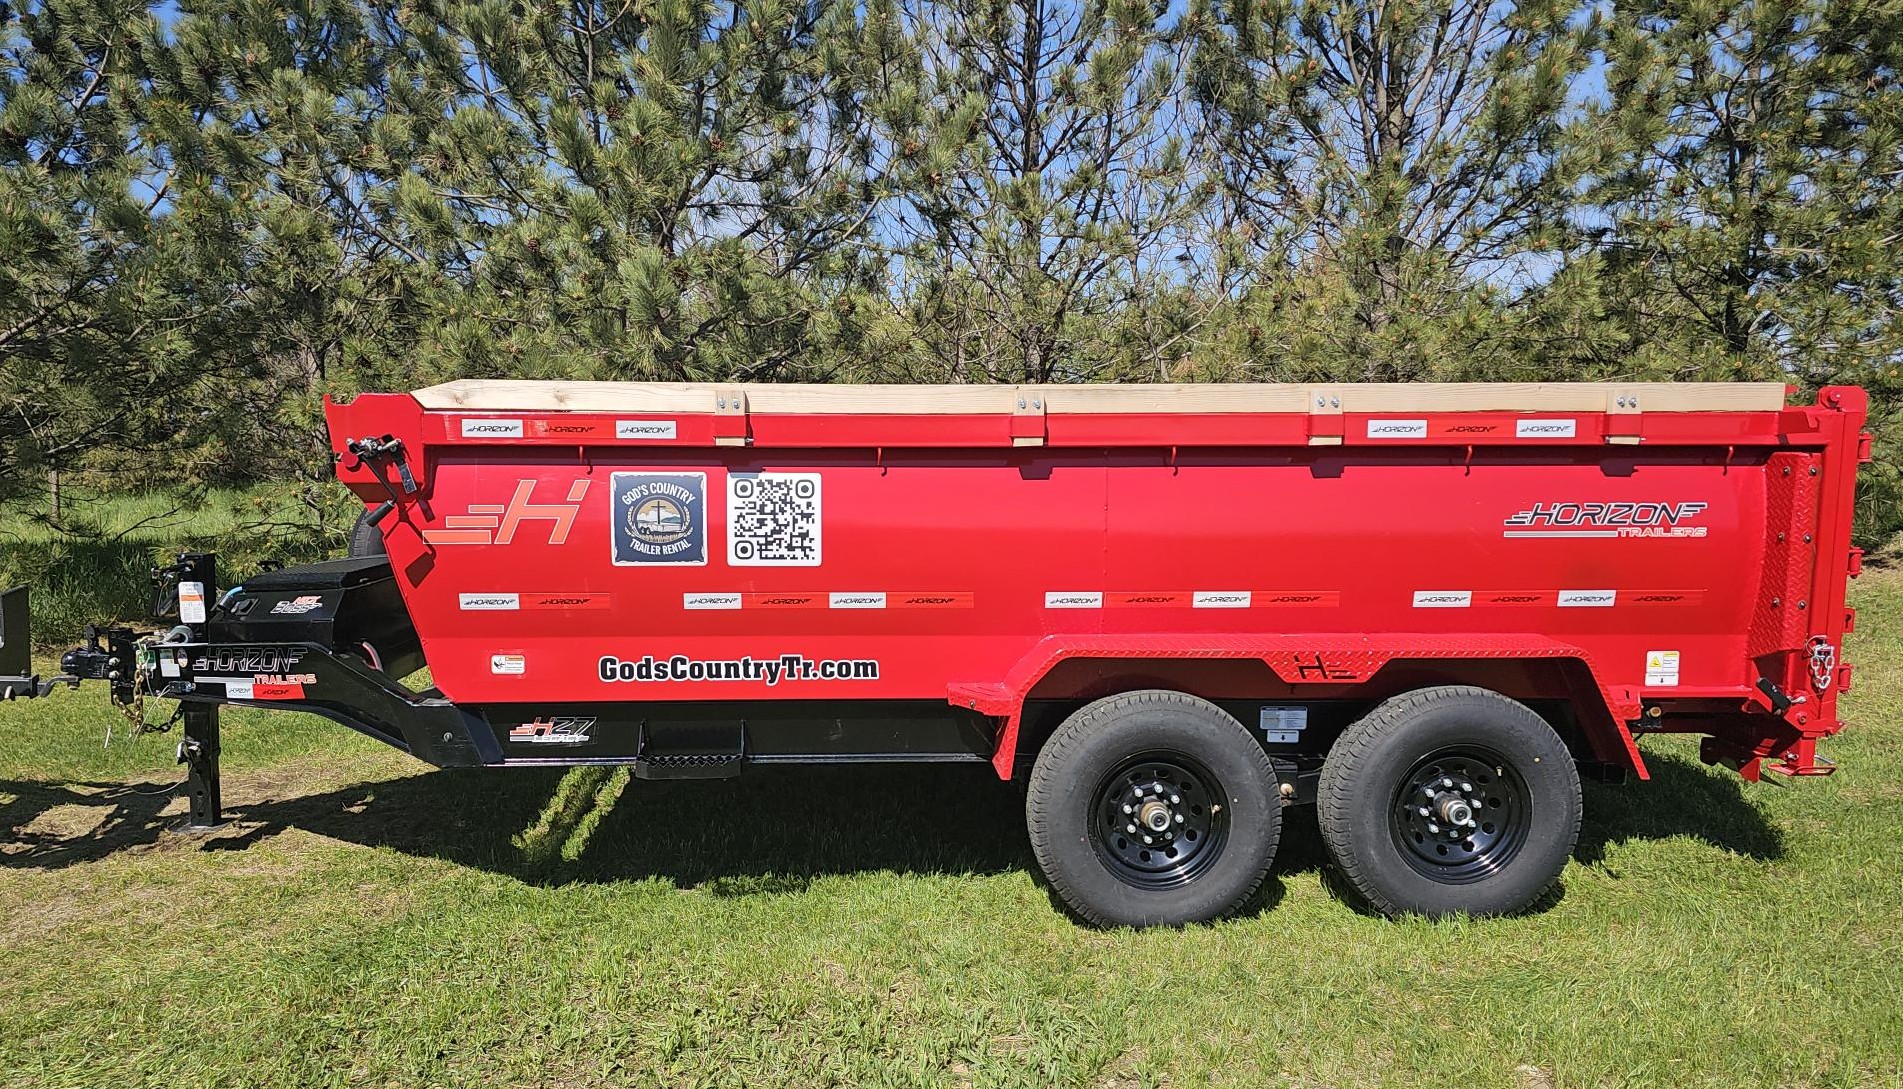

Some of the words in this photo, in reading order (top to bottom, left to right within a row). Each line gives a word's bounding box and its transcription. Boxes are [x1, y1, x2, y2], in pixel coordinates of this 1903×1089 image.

[468, 425, 517, 433] HORIZON
[1375, 425, 1420, 433] HORIZON
[1448, 425, 1493, 433] HORIZON
[1523, 425, 1568, 433] HORIZON
[621, 484, 649, 505] GOD'S
[649, 482, 696, 504] COUNTRY
[1526, 502, 1688, 526] HORIZON
[1616, 527, 1708, 537] TRAILERS
[629, 538, 661, 555] TRAILER
[662, 538, 692, 555] RENTAL
[467, 598, 513, 606] HORIZON
[691, 597, 736, 605] HORIZON
[837, 597, 880, 605] HORIZON
[908, 597, 951, 605] HORIZON
[1053, 597, 1096, 605] HORIZON
[1566, 595, 1610, 603] HORIZON
[203, 647, 296, 672] HORIZON
[598, 655, 879, 685] GodsCountryTr.com
[254, 673, 317, 685] TRAILERS
